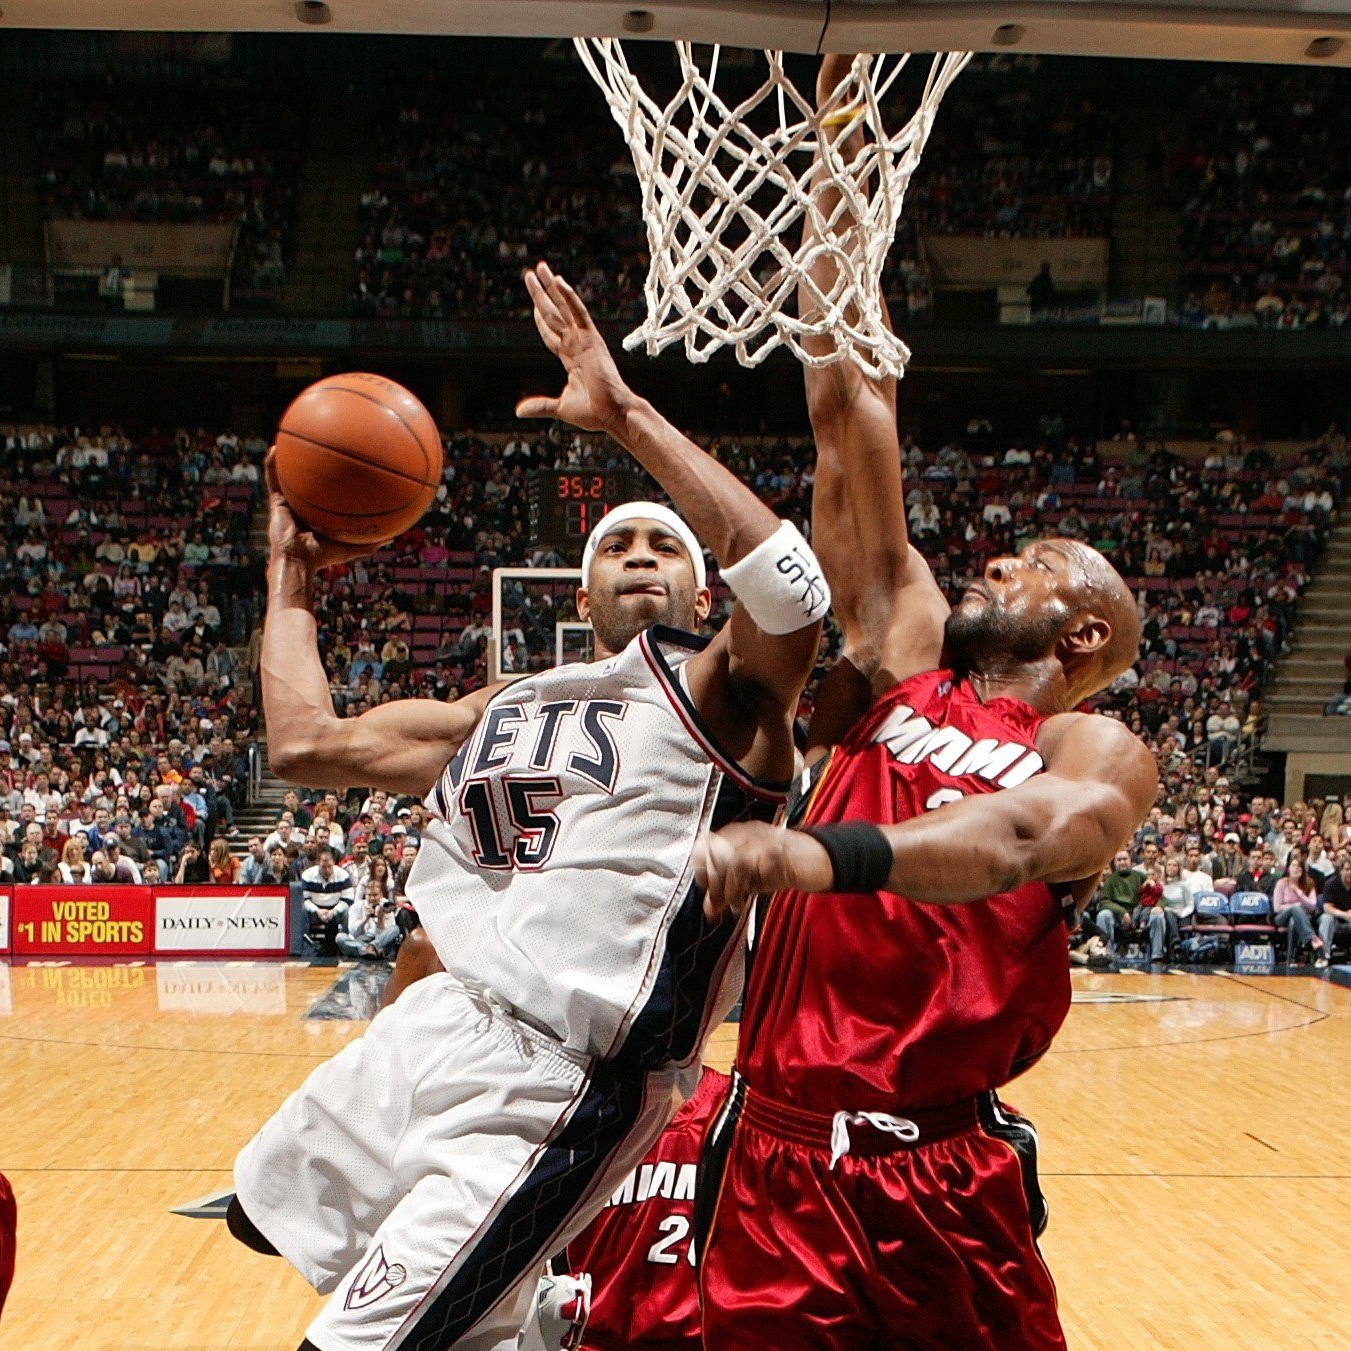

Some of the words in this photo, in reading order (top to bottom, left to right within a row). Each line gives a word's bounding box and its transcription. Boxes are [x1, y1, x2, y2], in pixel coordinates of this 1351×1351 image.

[556, 474, 605, 500] 35.2
[871, 704, 1043, 789] MIAMI
[459, 776, 563, 872] 15
[52, 901, 110, 921] VOTED
[161, 917, 216, 930] DAILY
[226, 916, 279, 930] NEWS
[42, 921, 61, 942] IN
[66, 921, 144, 943] SPORTS
[1240, 944, 1272, 961] ADT
[604, 1161, 697, 1208] MIAM
